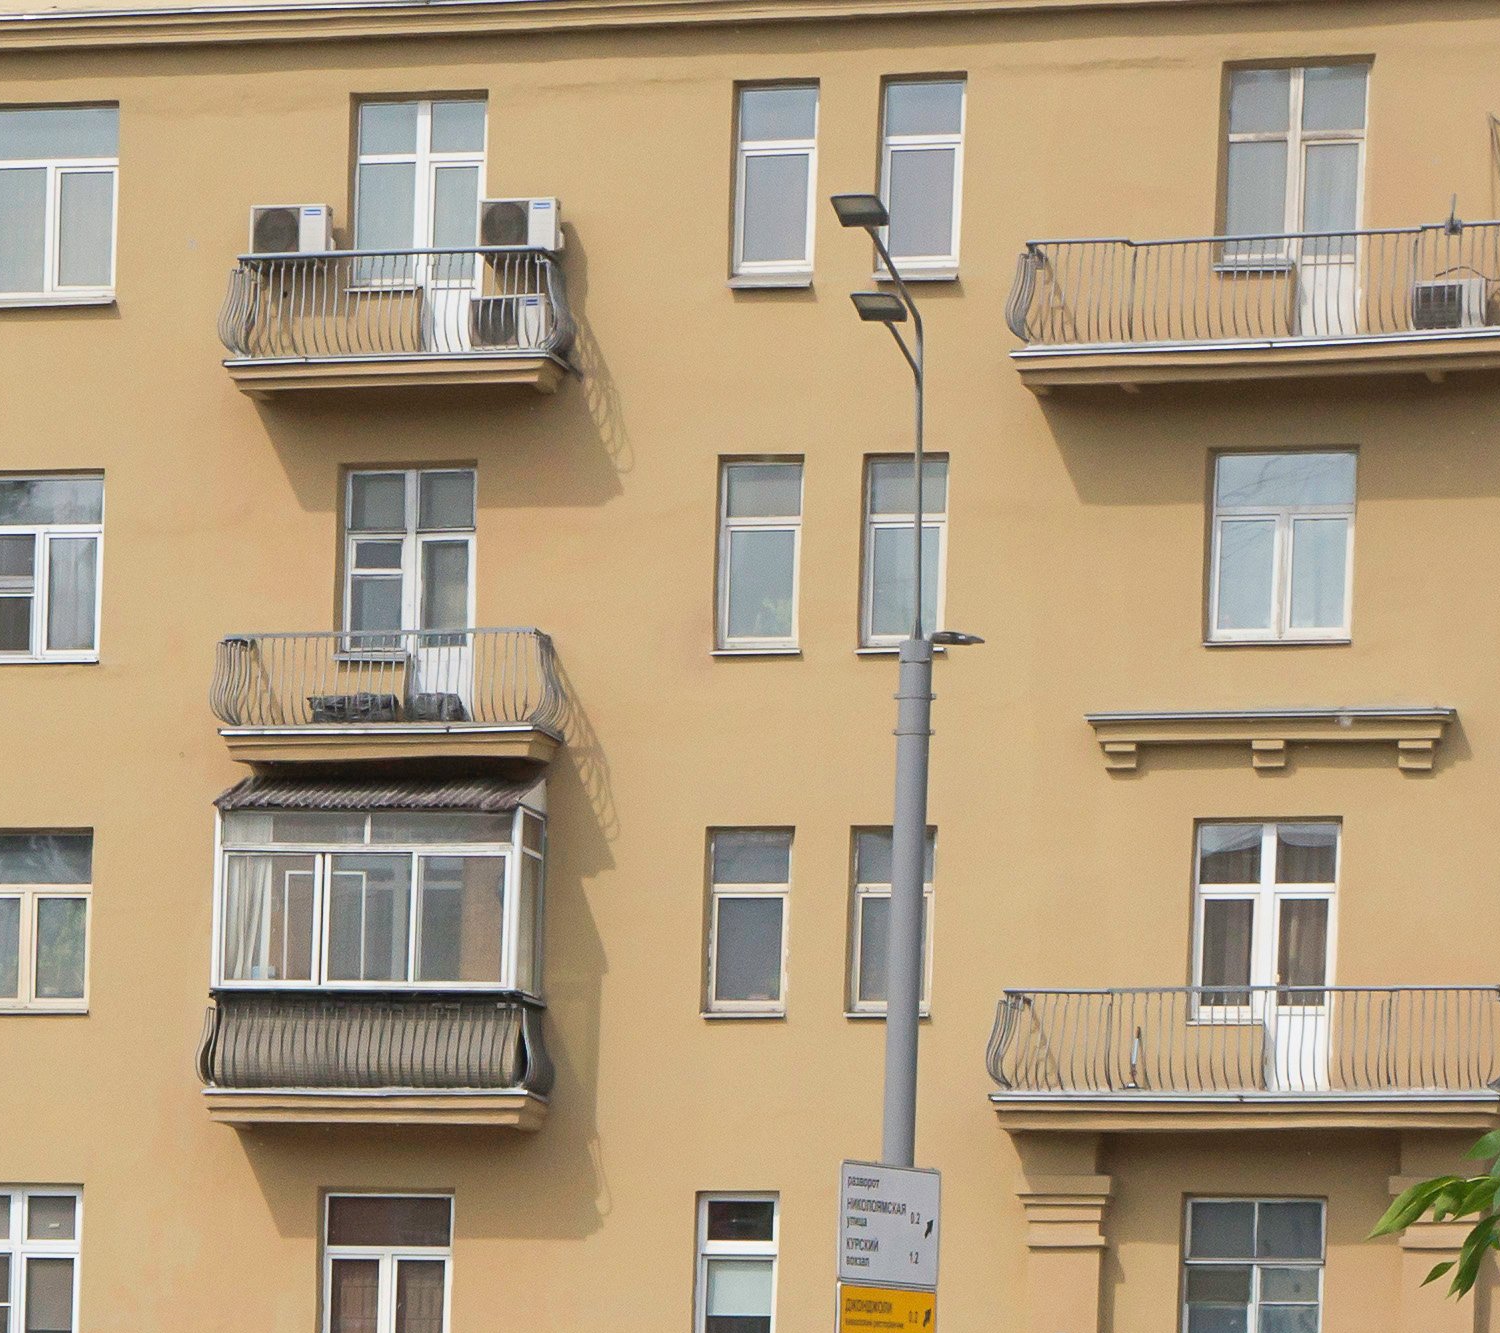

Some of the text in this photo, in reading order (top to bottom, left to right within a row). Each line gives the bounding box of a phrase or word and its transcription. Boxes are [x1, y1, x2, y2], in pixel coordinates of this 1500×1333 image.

[847, 1176, 880, 1191] разворот
[846, 1197, 907, 1216] НИКОЛОЯМСКАЯ
[910, 1211, 921, 1225] 0.2
[846, 1237, 879, 1253] КУРСКИЙ
[846, 1255, 870, 1267] вокзал
[908, 1250, 920, 1265] 1.2
